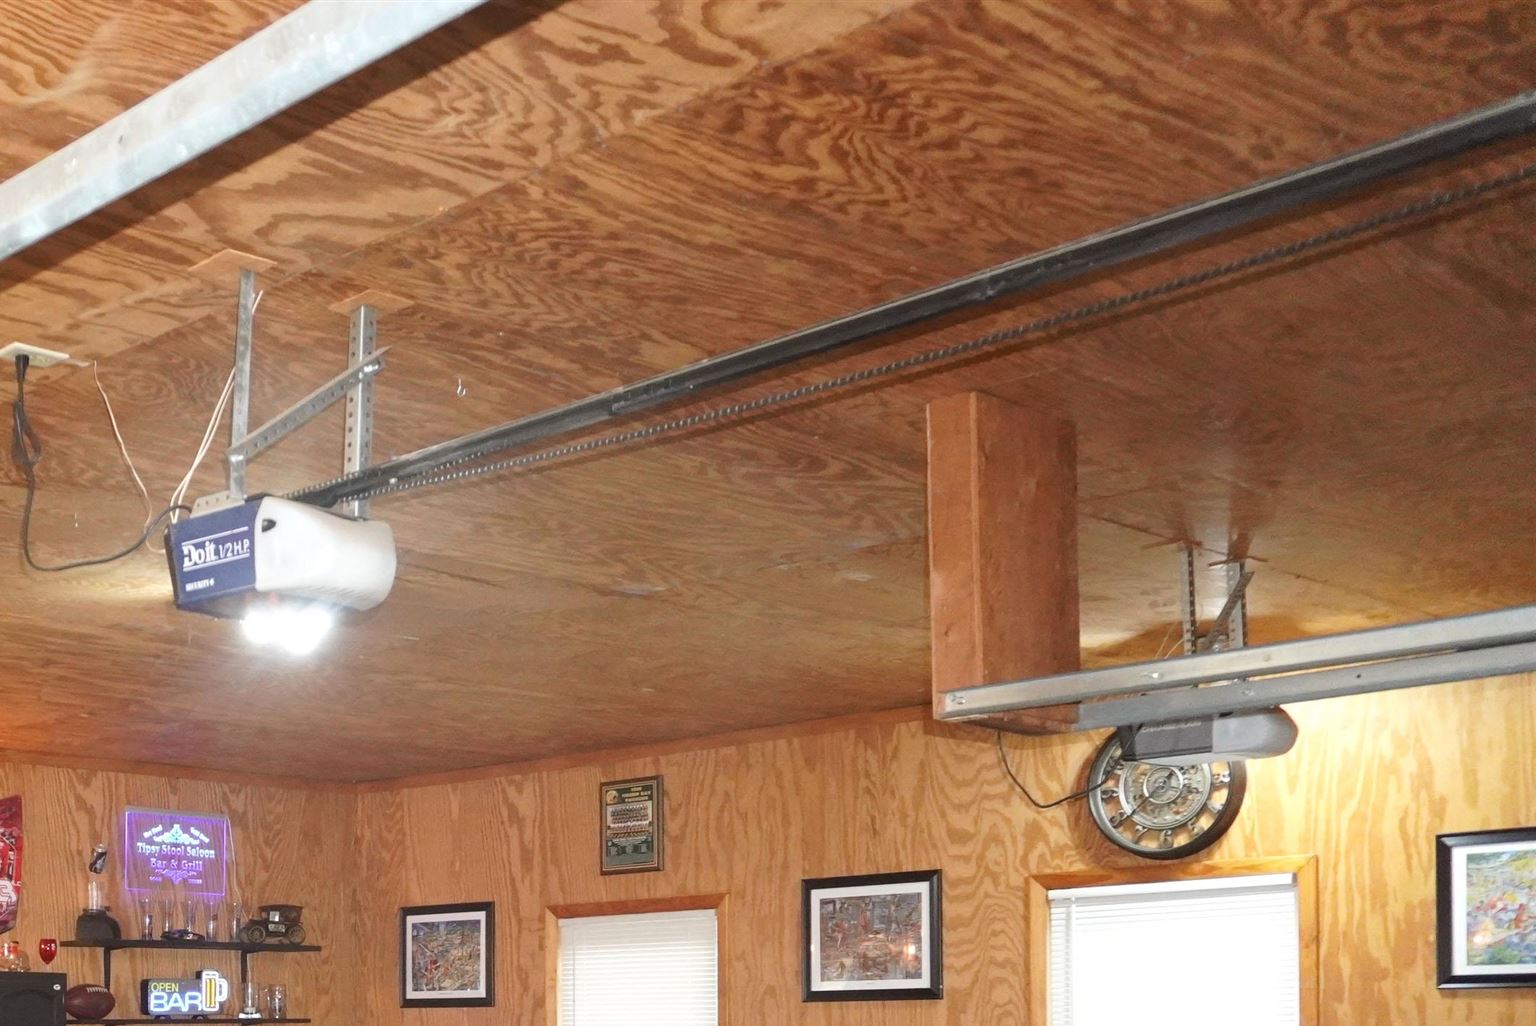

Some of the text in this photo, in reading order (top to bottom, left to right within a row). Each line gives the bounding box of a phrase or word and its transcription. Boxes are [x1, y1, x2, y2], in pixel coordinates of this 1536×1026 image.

[136, 842, 216, 859] Tipsy Stool Saloon
[150, 857, 203, 872] Bar & Grill
[150, 982, 179, 993] OPEN
[149, 991, 202, 1013] BAR
